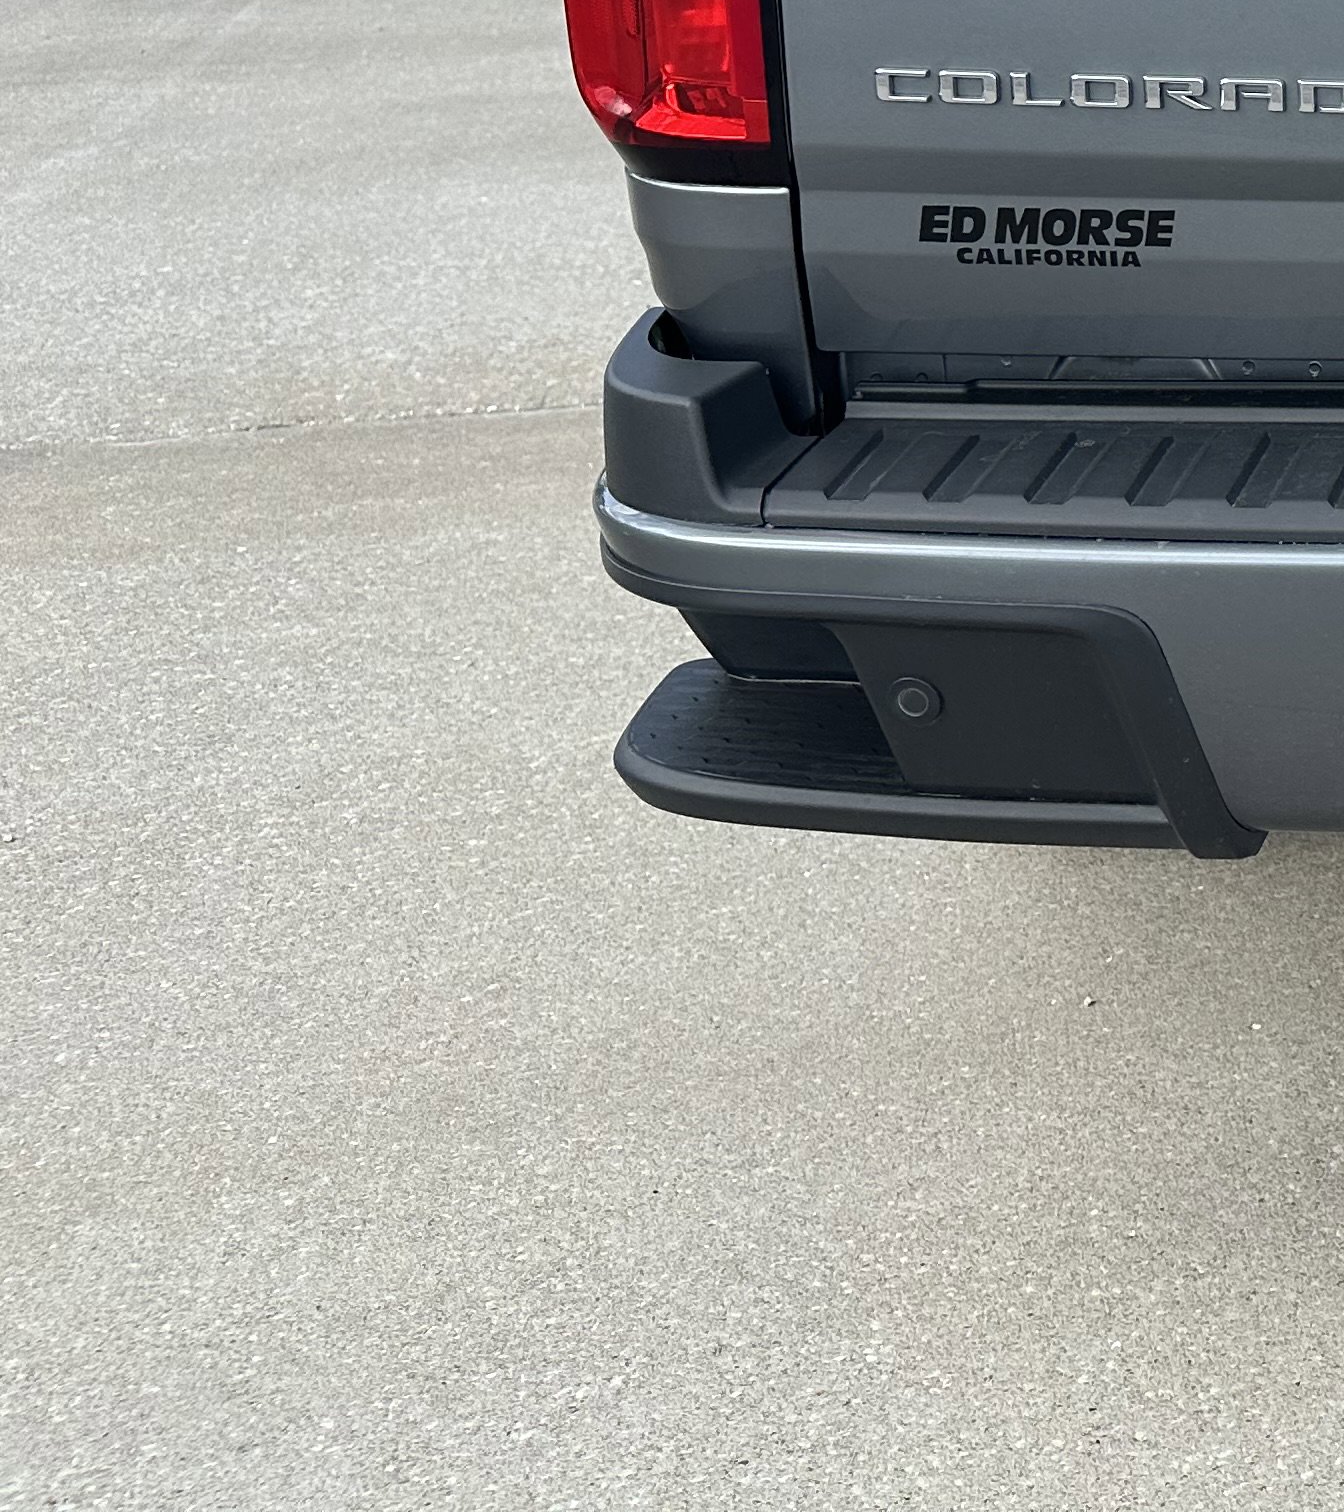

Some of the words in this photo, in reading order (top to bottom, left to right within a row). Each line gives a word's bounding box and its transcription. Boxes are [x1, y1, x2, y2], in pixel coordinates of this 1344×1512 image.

[918, 204, 986, 243] ED
[994, 206, 1176, 248] MORSE
[956, 246, 1142, 268] CALIFORNIA
